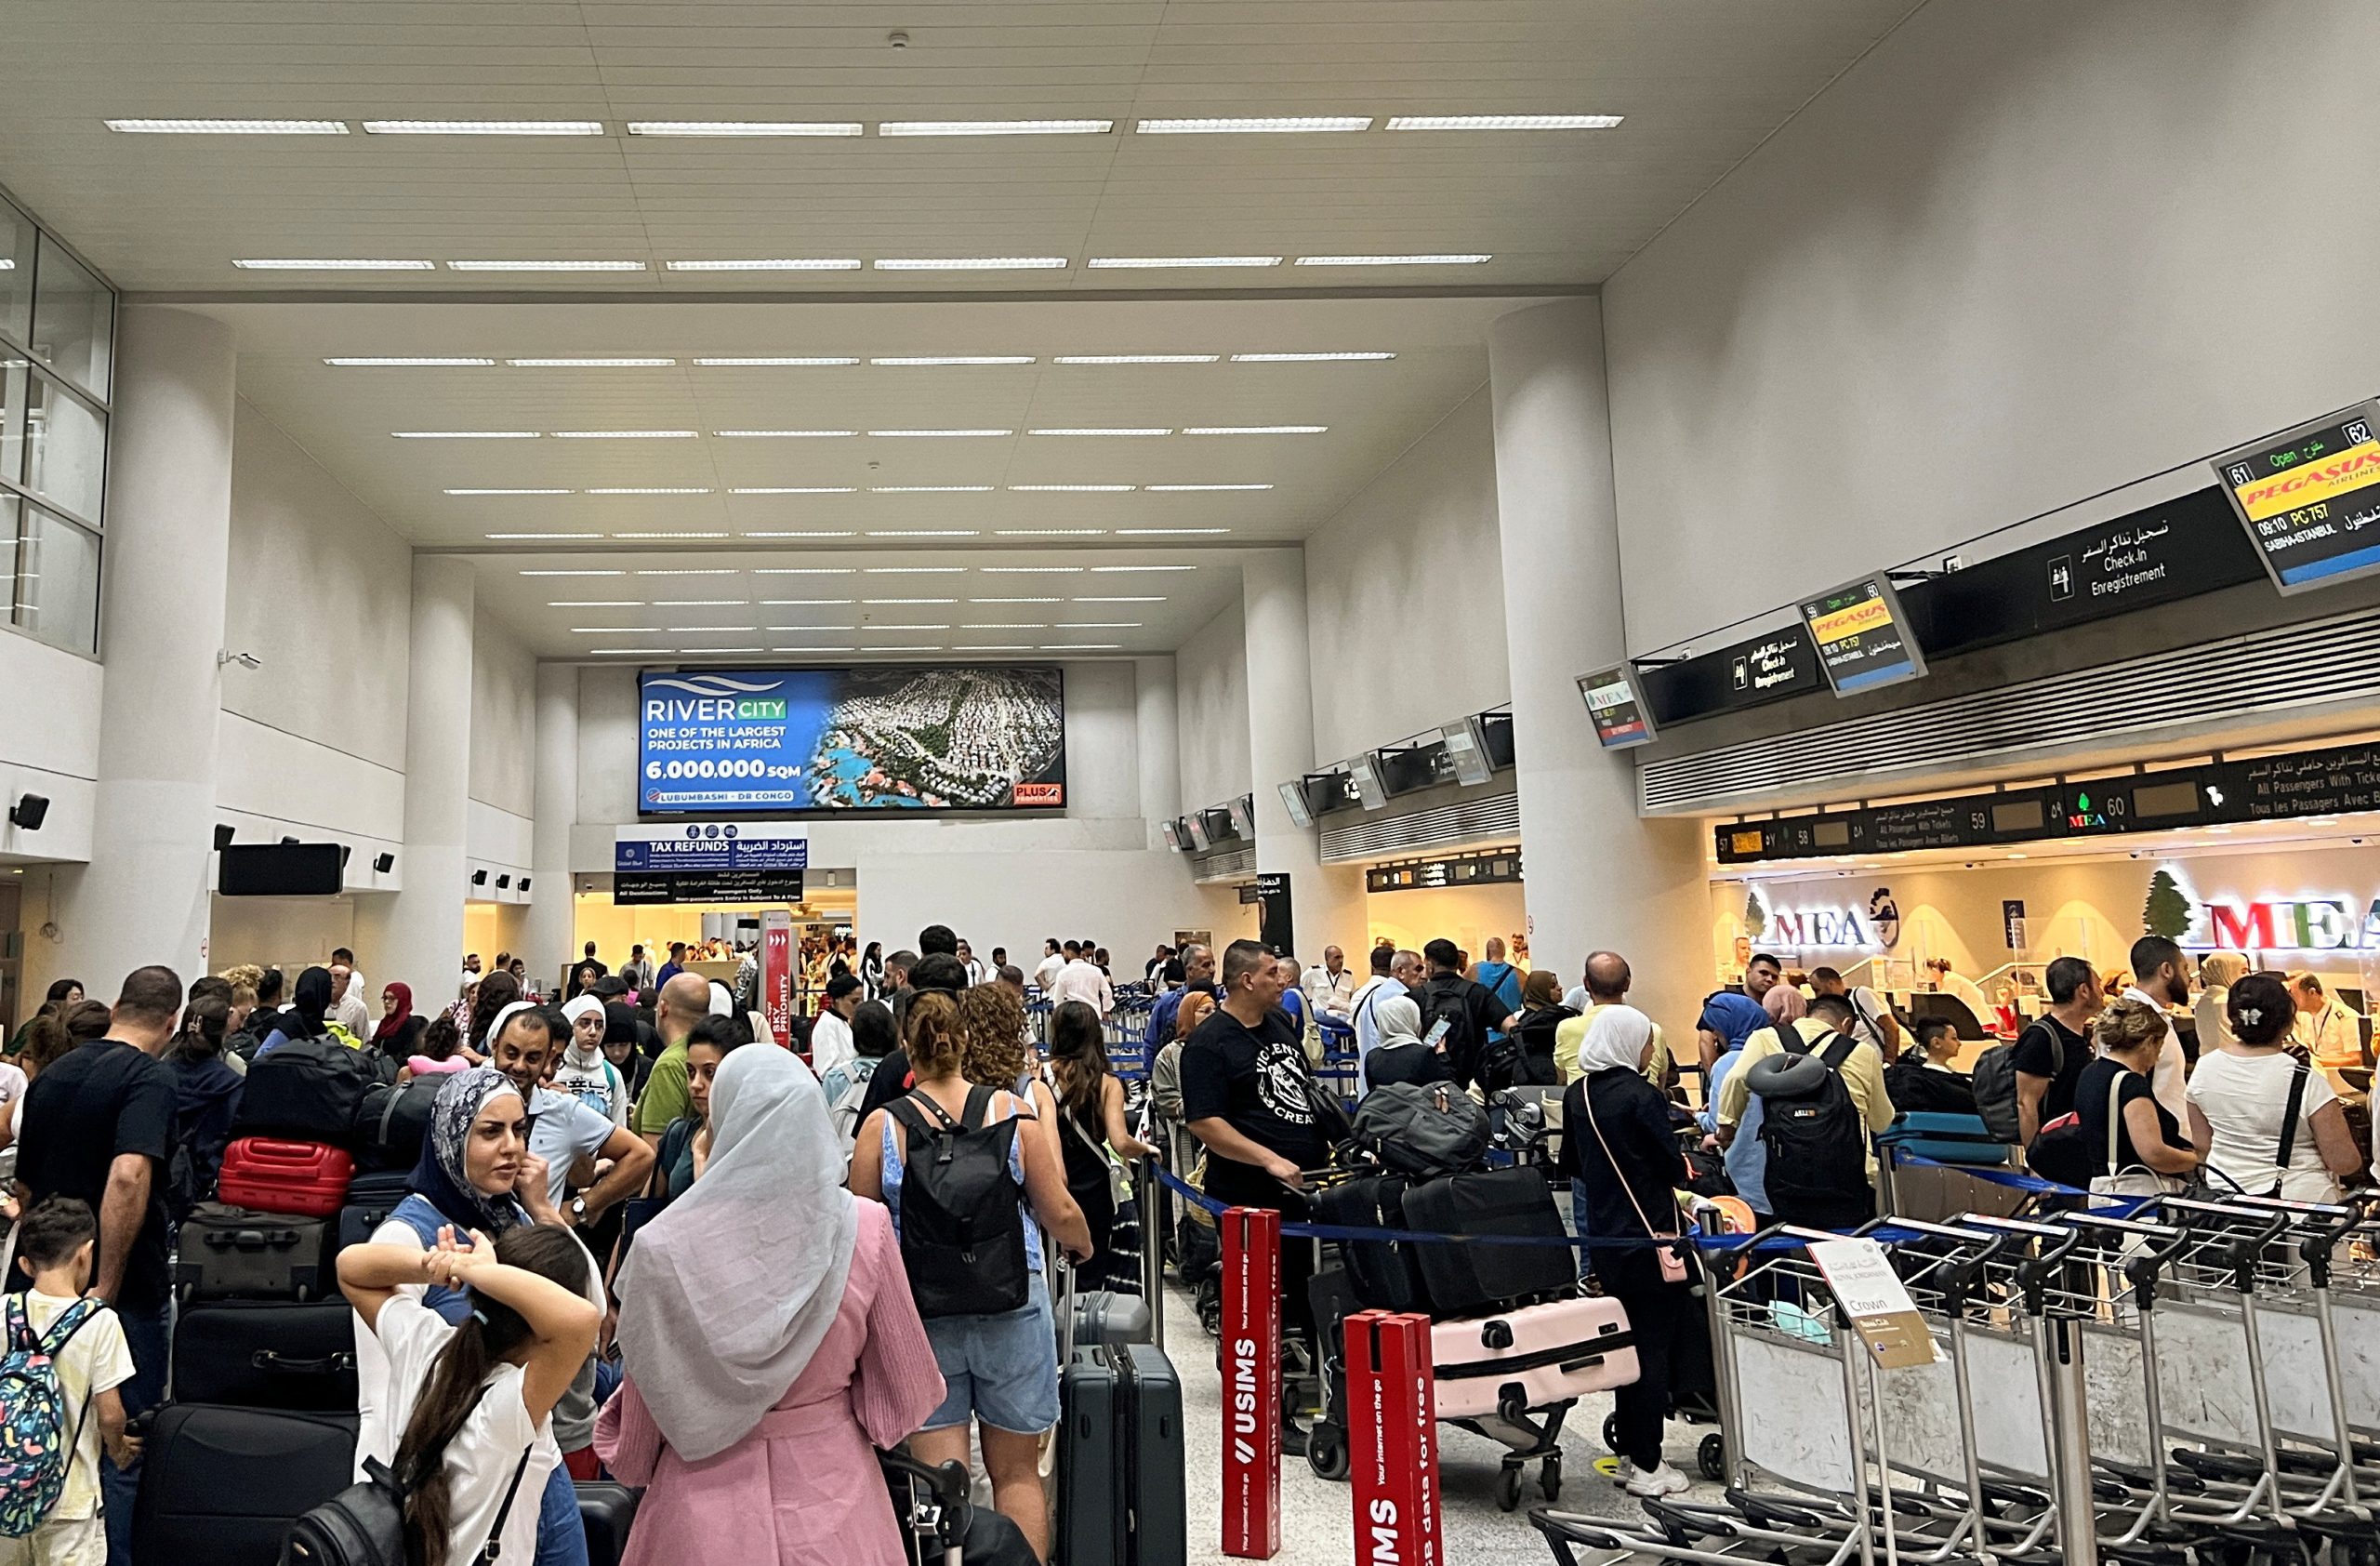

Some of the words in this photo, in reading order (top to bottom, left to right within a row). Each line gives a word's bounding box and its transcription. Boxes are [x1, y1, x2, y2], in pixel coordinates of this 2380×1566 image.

[2348, 423, 2371, 444] 62
[2269, 450, 2297, 468] Open
[2231, 467, 2250, 484] 61
[2246, 451, 2380, 506] PEGASUS
[2258, 517, 2287, 537] 09:10
[2290, 511, 2308, 526] PC
[2310, 503, 2329, 523] 757
[2109, 531, 2132, 554] تذاكر
[2133, 520, 2169, 545] تسجيل
[2082, 539, 2107, 563] السفر
[2104, 548, 2147, 572] Check-In
[2092, 563, 2165, 596] Enregistrement
[1867, 585, 1879, 597] 60
[1816, 604, 1885, 634] PEGASUS
[646, 699, 735, 722] RIVER
[738, 701, 785, 717] CITY
[648, 728, 676, 738] ONE
[680, 727, 696, 737] OF
[700, 727, 725, 737] THE
[729, 726, 787, 737] LARGEST
[648, 739, 714, 750] PROJECTS
[718, 738, 731, 750] IN
[734, 738, 781, 749] AFRICA
[646, 759, 765, 779] 6,000,000
[767, 765, 801, 779] SQM
[1016, 788, 1047, 797] PLUS
[2257, 783, 2270, 796] All
[2274, 779, 2324, 795] Passengers
[2329, 773, 2351, 788] With
[660, 792, 728, 802] LUBUMBASHI
[738, 792, 751, 801] DR
[2107, 797, 2125, 816] 60
[2250, 803, 2270, 816] Tous
[2292, 797, 2338, 813] Passagers
[2344, 793, 2369, 806] Avec
[1971, 812, 1986, 829] 59
[2069, 814, 2106, 828] MEA
[650, 842, 672, 852] TAX
[675, 841, 729, 852] REFUNDS
[771, 840, 805, 852] استرداد
[1798, 829, 1808, 844] 58
[1773, 910, 1871, 946] MEA
[780, 974, 788, 1032] PRIORITY
[773, 1007, 781, 1032] SKY
[1243, 1254, 1249, 1263] go
[1242, 1276, 1249, 1285] on
[1849, 1299, 1888, 1312] Crown
[1235, 1338, 1256, 1434] USIMS
[1374, 1379, 1382, 1392] go
[1374, 1393, 1382, 1410] the
[1417, 1376, 1426, 1427] free
[1376, 1411, 1383, 1424] on
[1376, 1426, 1385, 1463] internet
[1419, 1434, 1429, 1469] for
[1243, 1473, 1250, 1483] go
[1377, 1464, 1385, 1486] Your
[1242, 1496, 1249, 1506] on
[1422, 1476, 1432, 1533] data
